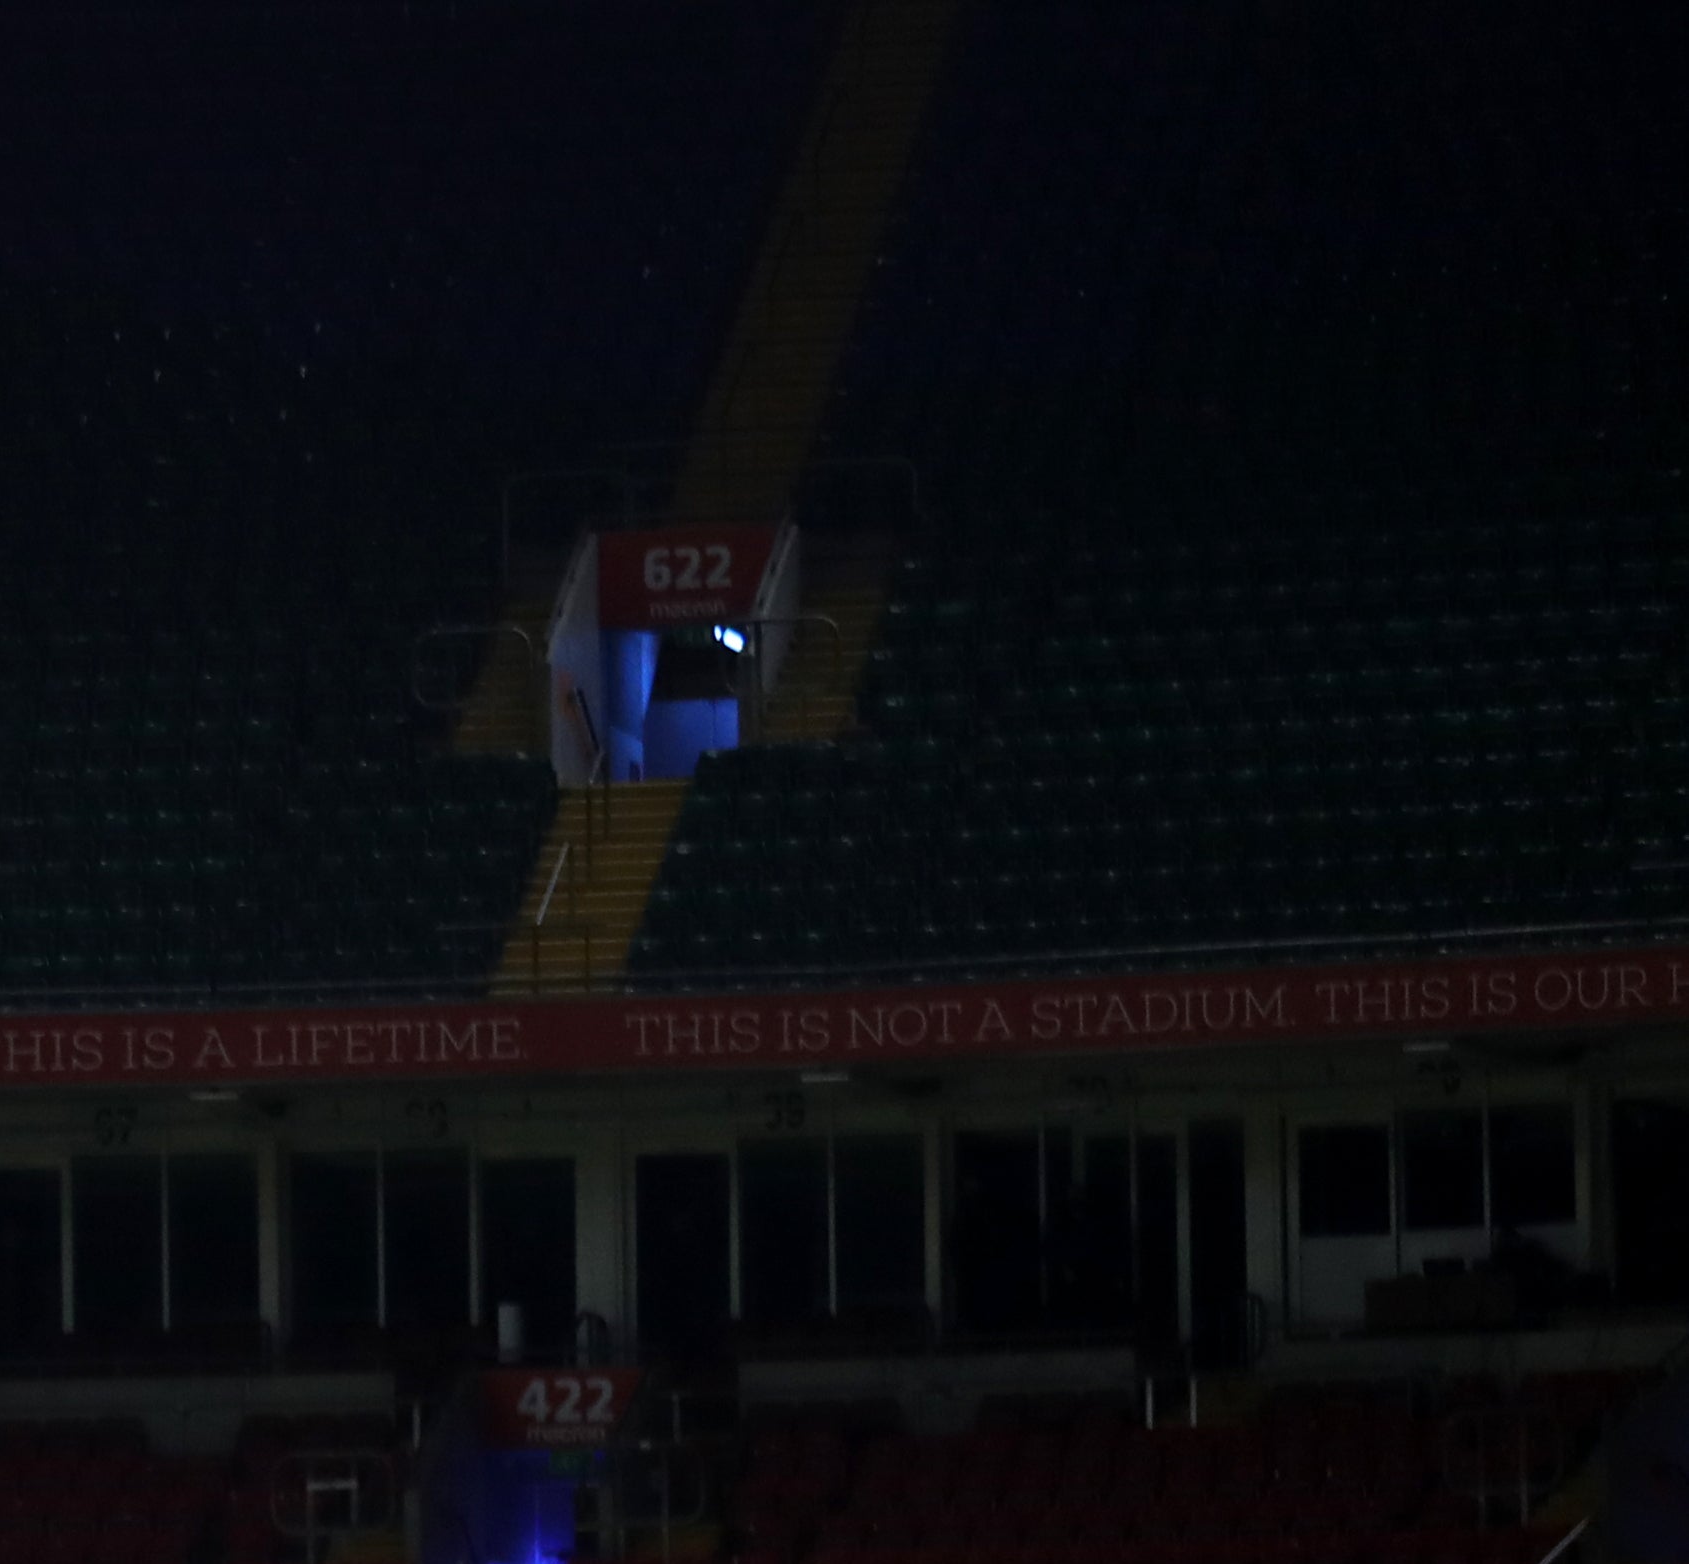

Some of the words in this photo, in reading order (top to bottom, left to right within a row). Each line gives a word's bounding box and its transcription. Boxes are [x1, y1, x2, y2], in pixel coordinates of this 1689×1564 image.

[643, 545, 732, 591] 622
[625, 1009, 762, 1056] THIS
[778, 1006, 831, 1052] IS
[847, 1000, 962, 1050] NOT
[972, 997, 1017, 1043] A
[1315, 973, 1451, 1026] THIS
[1467, 969, 1519, 1017] IS
[1533, 964, 1653, 1011] OUR
[121, 1027, 177, 1073] IS
[197, 1026, 236, 1070] A
[516, 1376, 615, 1424] 422
